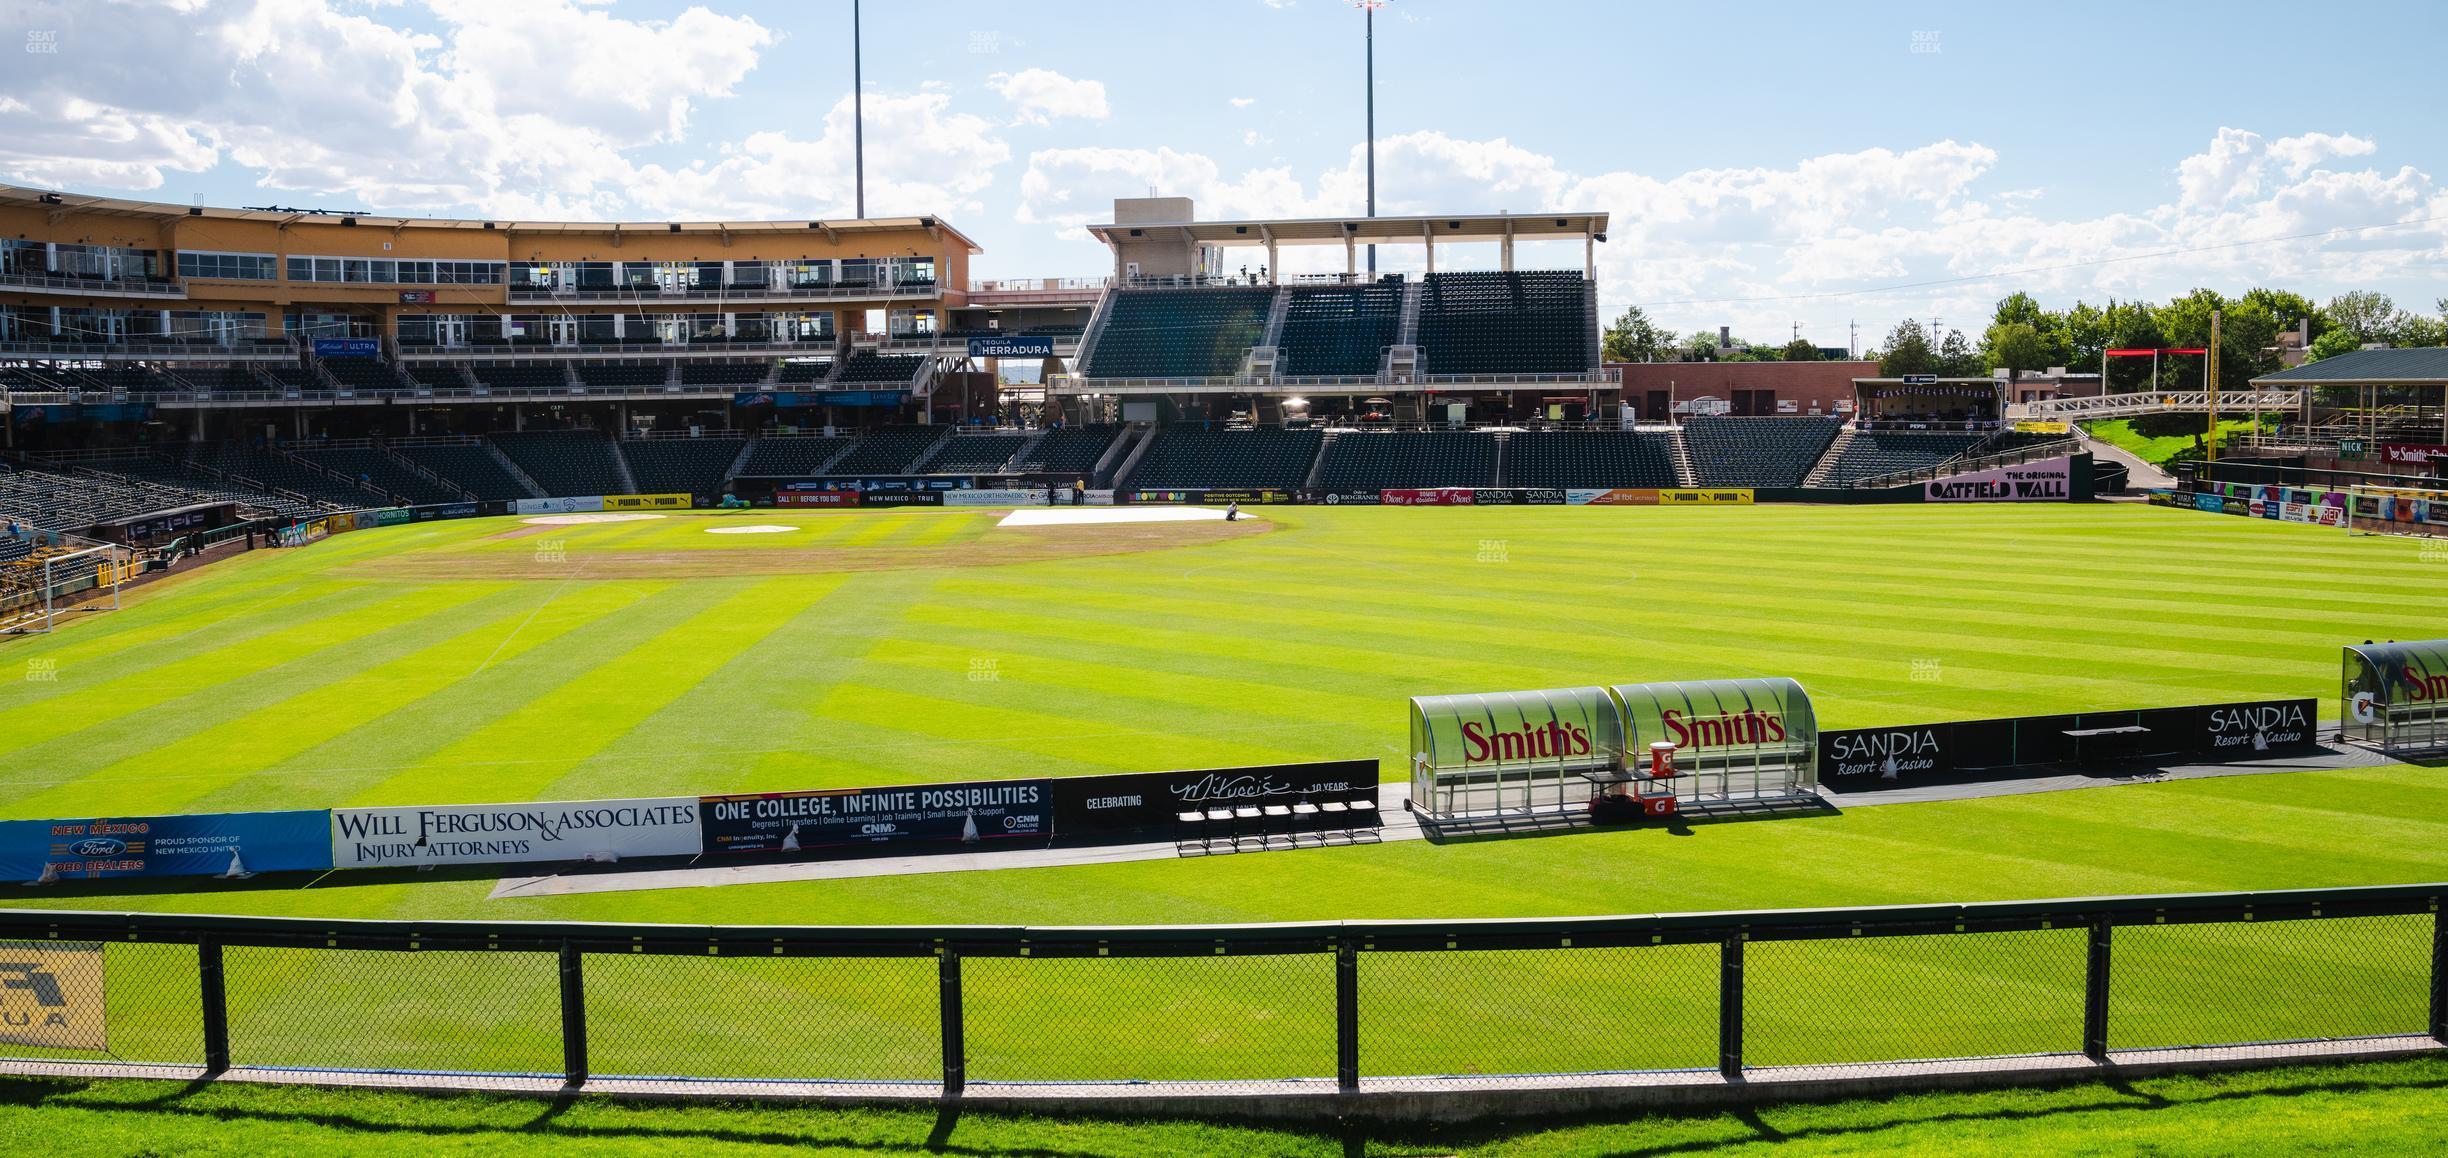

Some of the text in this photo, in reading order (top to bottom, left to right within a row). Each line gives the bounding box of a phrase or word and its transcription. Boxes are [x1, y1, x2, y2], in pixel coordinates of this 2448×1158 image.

[982, 346, 1050, 355] HERRADURA
[2341, 442, 2362, 451] NICK
[2005, 471, 2067, 480] THE ORIGINAL
[1475, 490, 1514, 499] SANDIA
[1525, 490, 1564, 499] SANDIA
[1930, 480, 2066, 499] OATFIELD WALL
[654, 497, 677, 505] PUMA
[1129, 492, 1186, 501] MEOW WOLF
[1383, 491, 1404, 503] Dion's
[1450, 491, 1472, 503] Dion's
[1674, 493, 1699, 501] PUMA
[1713, 493, 1738, 501] PUMA
[2323, 509, 2339, 521] RED
[2207, 704, 2307, 732] SANDIA
[1662, 707, 1786, 748] Smith's
[1463, 720, 1592, 762] Smith's
[2213, 733, 2250, 747] Resort
[2266, 729, 2301, 743] Casino
[1830, 729, 1940, 760] SANDIA
[1662, 753, 1671, 763] G
[1837, 760, 1877, 776] Resort
[1895, 755, 1934, 771] Casino
[1312, 782, 1349, 792] 10 YEARS
[715, 786, 1039, 821] ONE COLLEGE, INFINITE POSSIBILITIES
[1087, 795, 1142, 810] CELEBRATING
[1655, 800, 1665, 812] G
[337, 805, 695, 841] WILL FERGUSON & ASSOCIATES
[751, 819, 780, 830] Degrees
[785, 817, 818, 827] Transfers
[823, 815, 844, 825] Online
[846, 814, 876, 825] Learning
[881, 812, 893, 822] Job
[895, 811, 922, 822] Training
[927, 810, 945, 819] Small
[978, 807, 1006, 817] Support
[1016, 815, 1039, 823] CNM
[52, 823, 149, 836] NEW MEXICO
[861, 823, 892, 834] CNM
[155, 835, 241, 846] PROUD SPONSOR OF
[80, 840, 116, 856] Ford
[355, 839, 530, 863] INJURY ATTORNEYS
[86, 860, 145, 872] DEALERS
